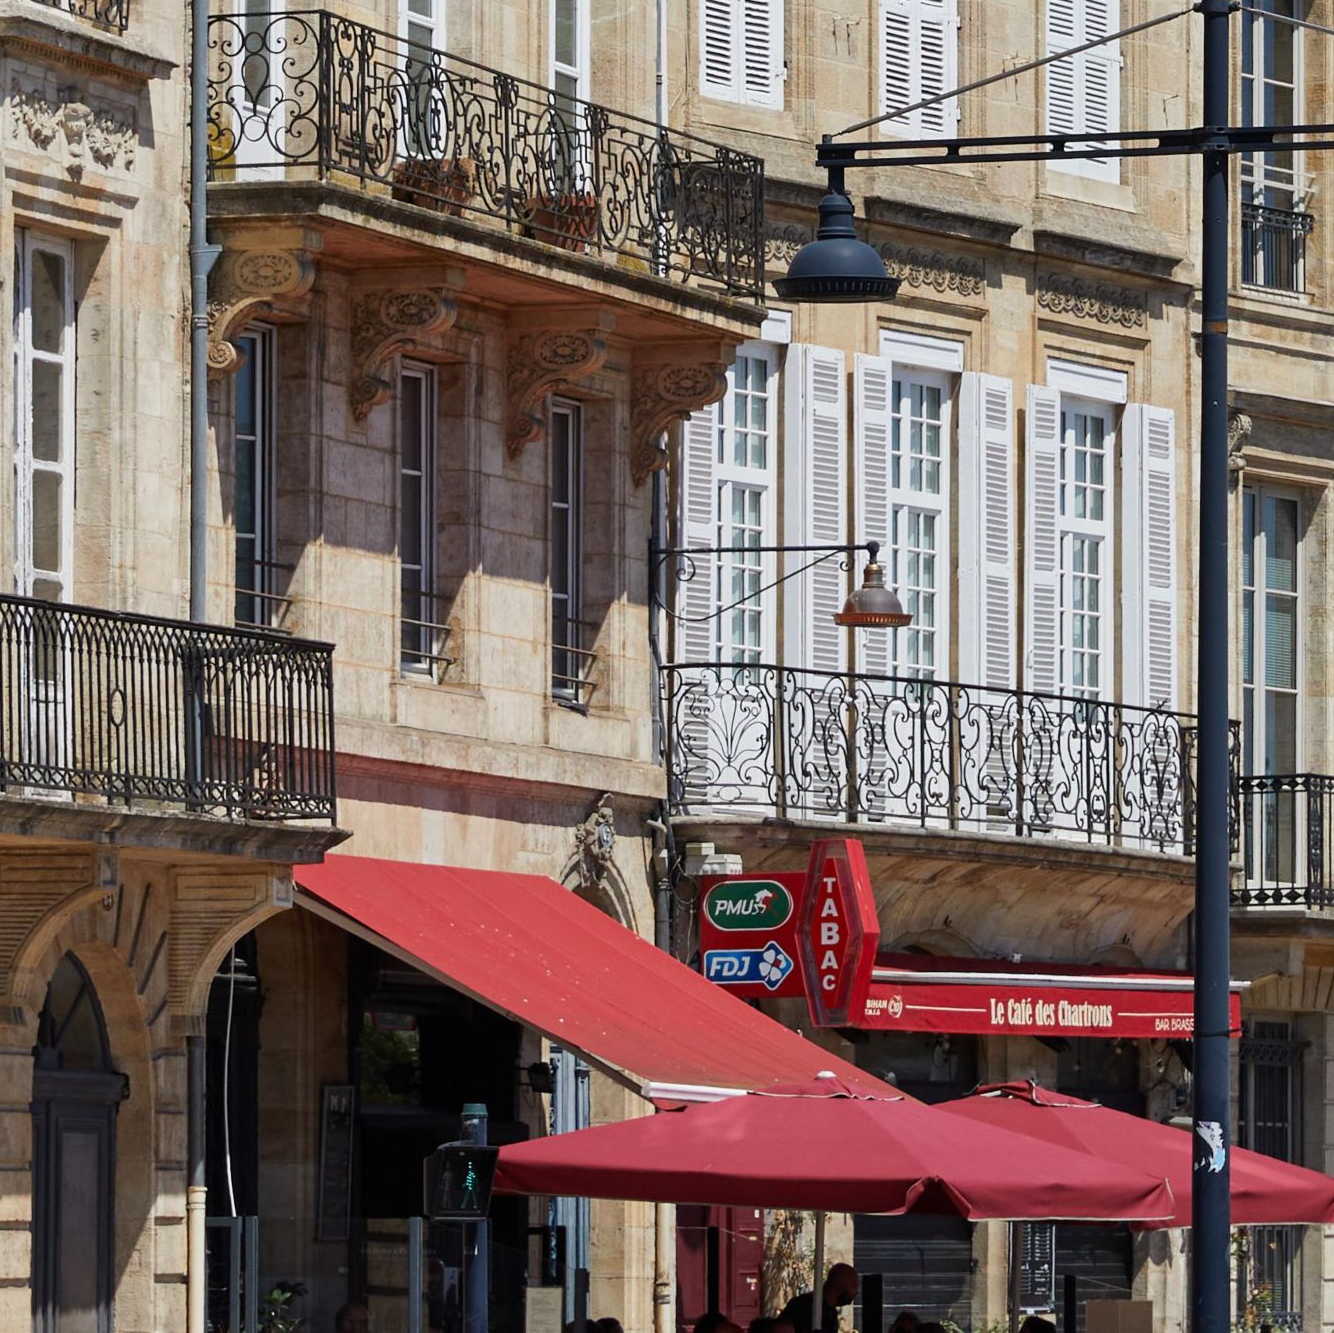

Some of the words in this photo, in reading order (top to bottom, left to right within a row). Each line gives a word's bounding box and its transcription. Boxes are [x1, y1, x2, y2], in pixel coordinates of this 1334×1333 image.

[715, 899, 752, 916] PMU
[820, 877, 840, 991] TABAC
[710, 956, 750, 977] FDJ
[990, 998, 1004, 1024] Le
[1008, 998, 1032, 1025] Café
[1035, 1000, 1055, 1026] des
[1058, 1000, 1112, 1027] Chartrons
[1155, 1018, 1170, 1031] BAR
